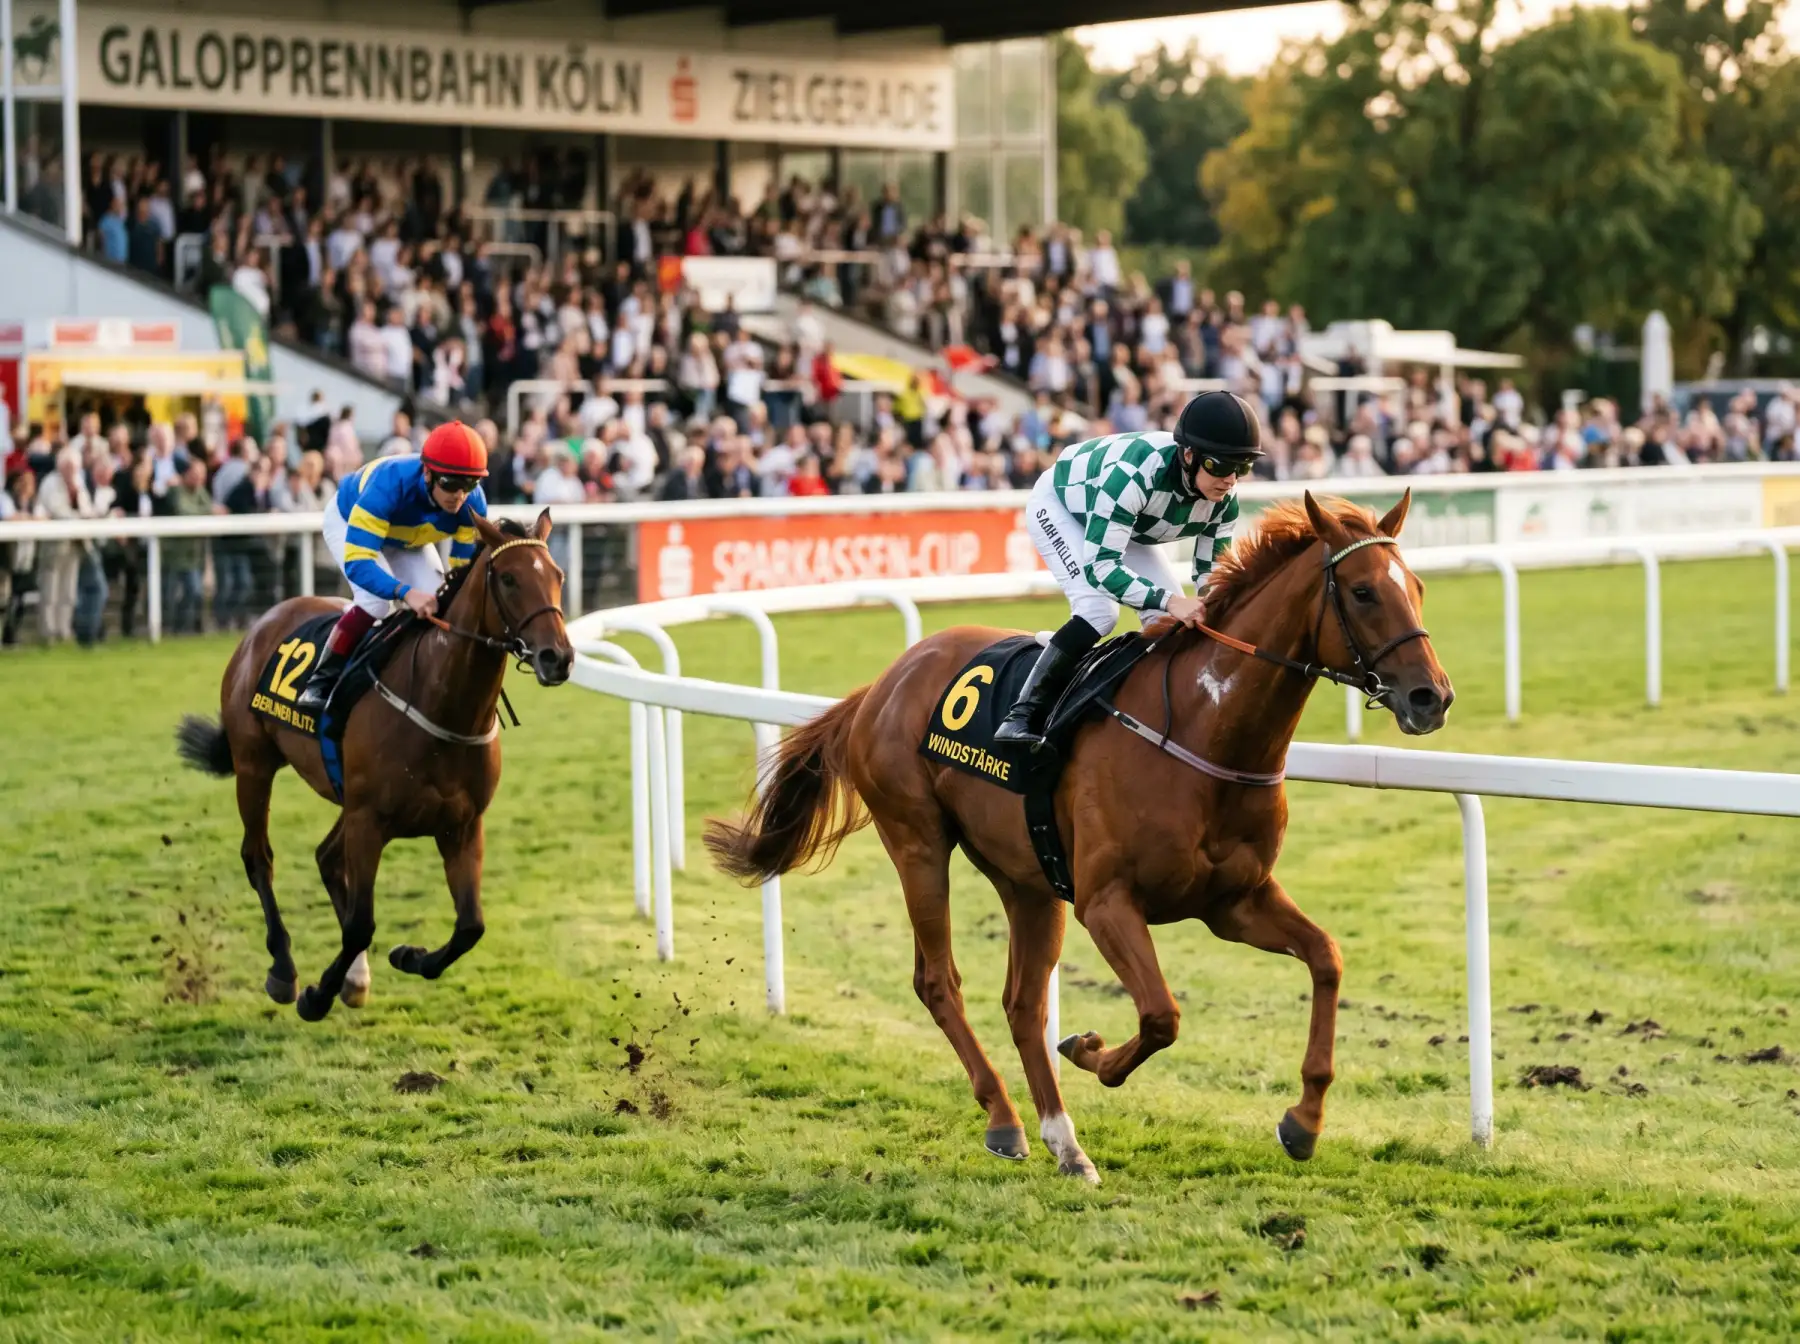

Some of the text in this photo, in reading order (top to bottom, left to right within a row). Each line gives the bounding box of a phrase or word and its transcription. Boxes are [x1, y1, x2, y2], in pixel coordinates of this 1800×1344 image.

[99, 25, 643, 116] GALOPPRENNBAHN KÖLN
[731, 68, 944, 131] ZIELGERADE
[712, 530, 982, 593] SPARKASSEN-CUP
[269, 637, 316, 702] 12
[941, 664, 994, 731] 6
[291, 710, 316, 733] BLITZ
[927, 732, 1012, 781] WINDSTÄRKE
